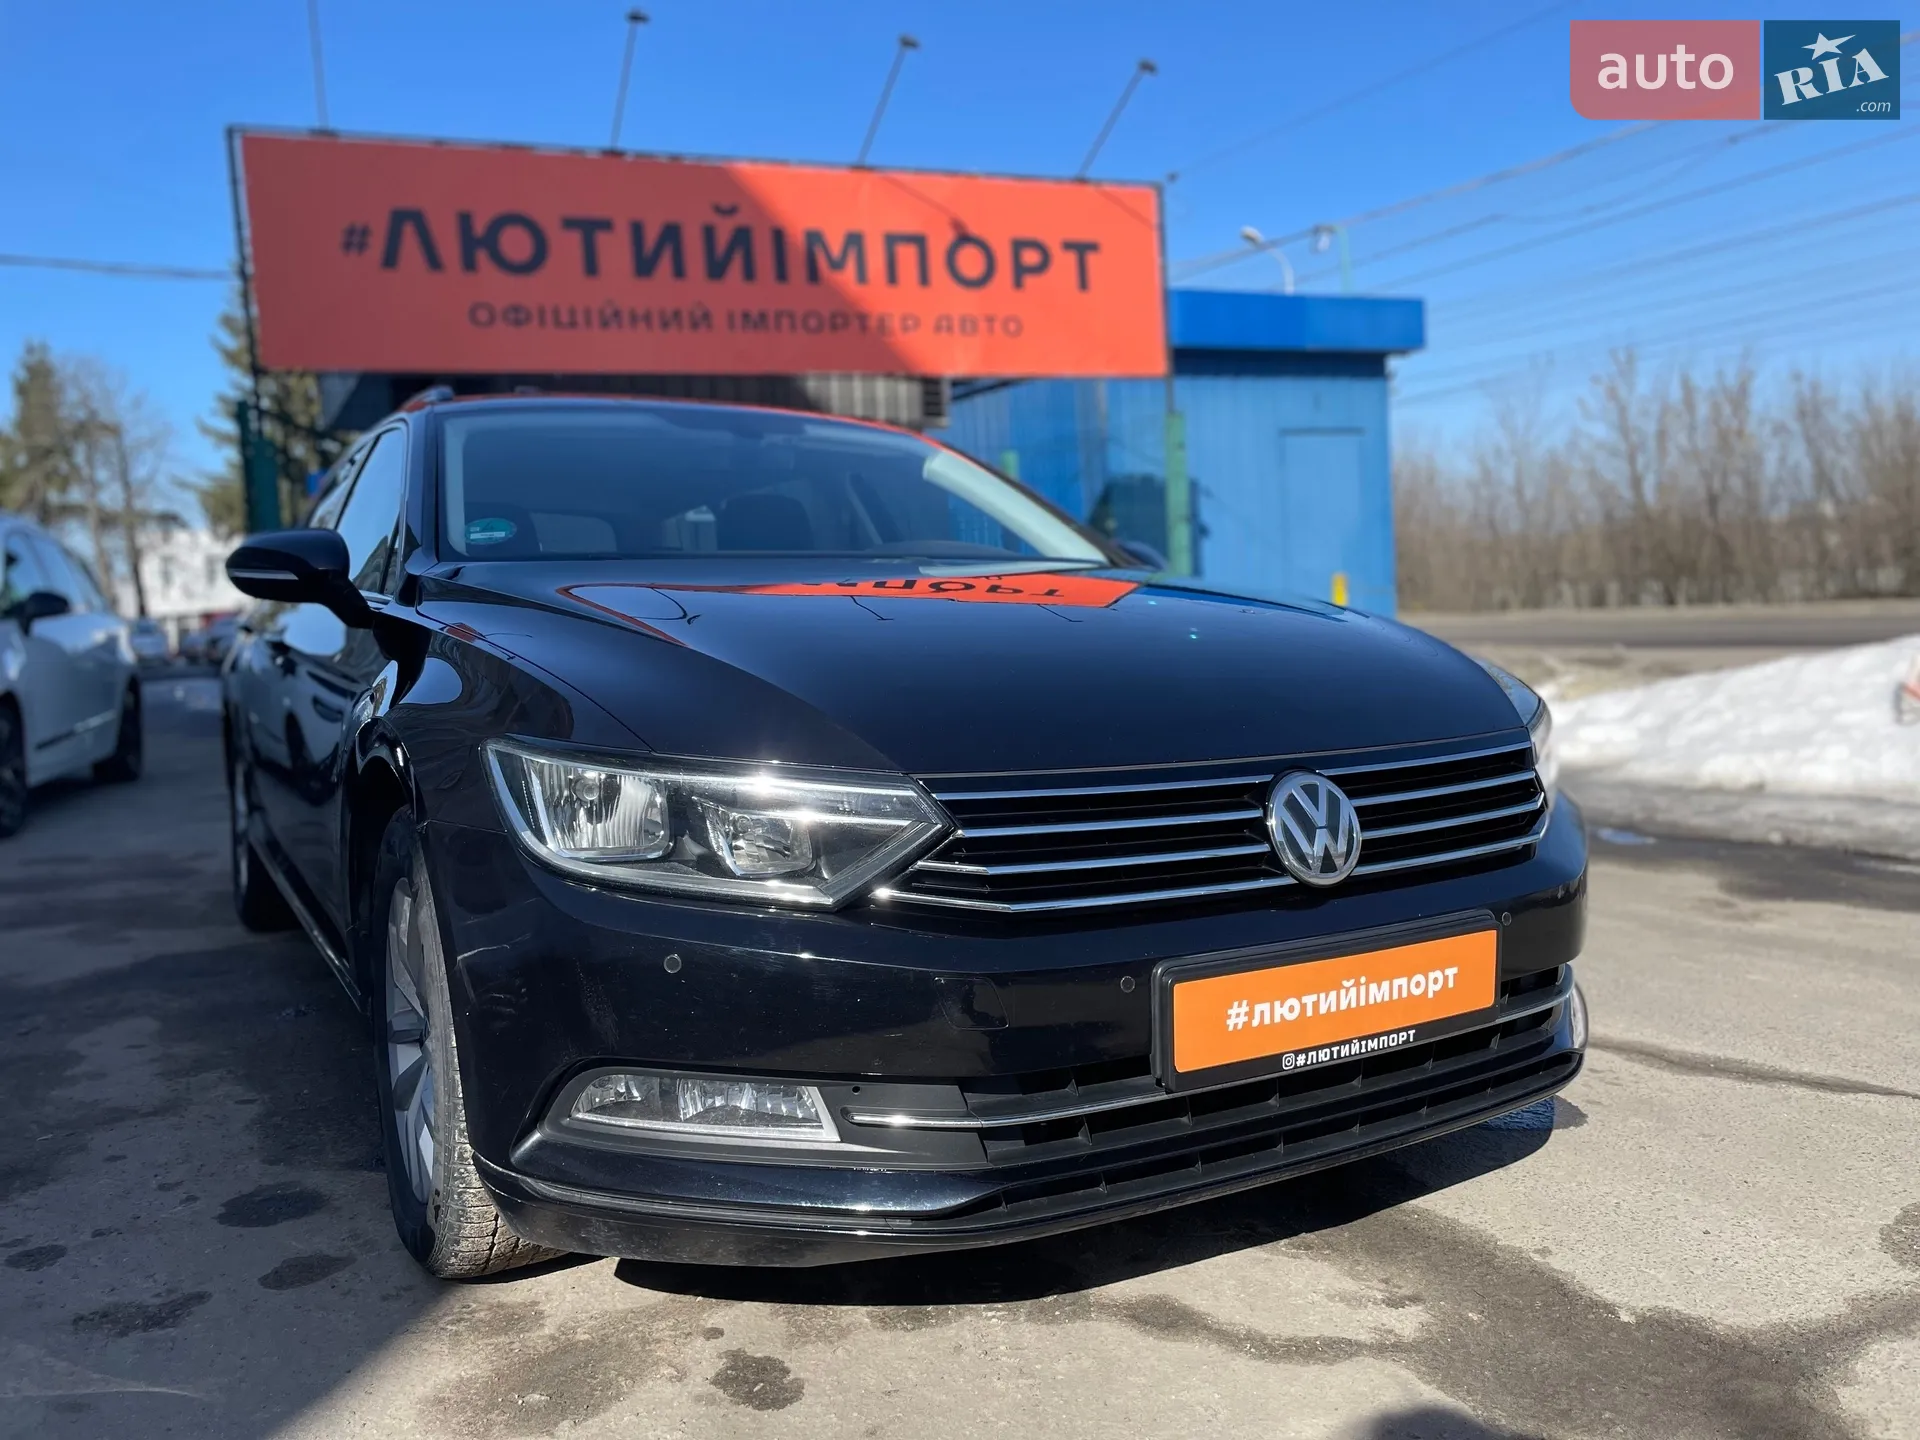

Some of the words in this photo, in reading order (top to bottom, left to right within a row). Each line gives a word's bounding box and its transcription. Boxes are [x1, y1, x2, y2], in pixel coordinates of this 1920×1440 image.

[340, 203, 1101, 293] #ЛЮТИЙІМПОРТ
[727, 308, 921, 336] ІМПОРТЕР
[933, 314, 1023, 338] АВТО
[1226, 966, 1458, 1031] #лютийімпорт
[1296, 1030, 1416, 1067] #ЛЮТИЙІМПОРТ
